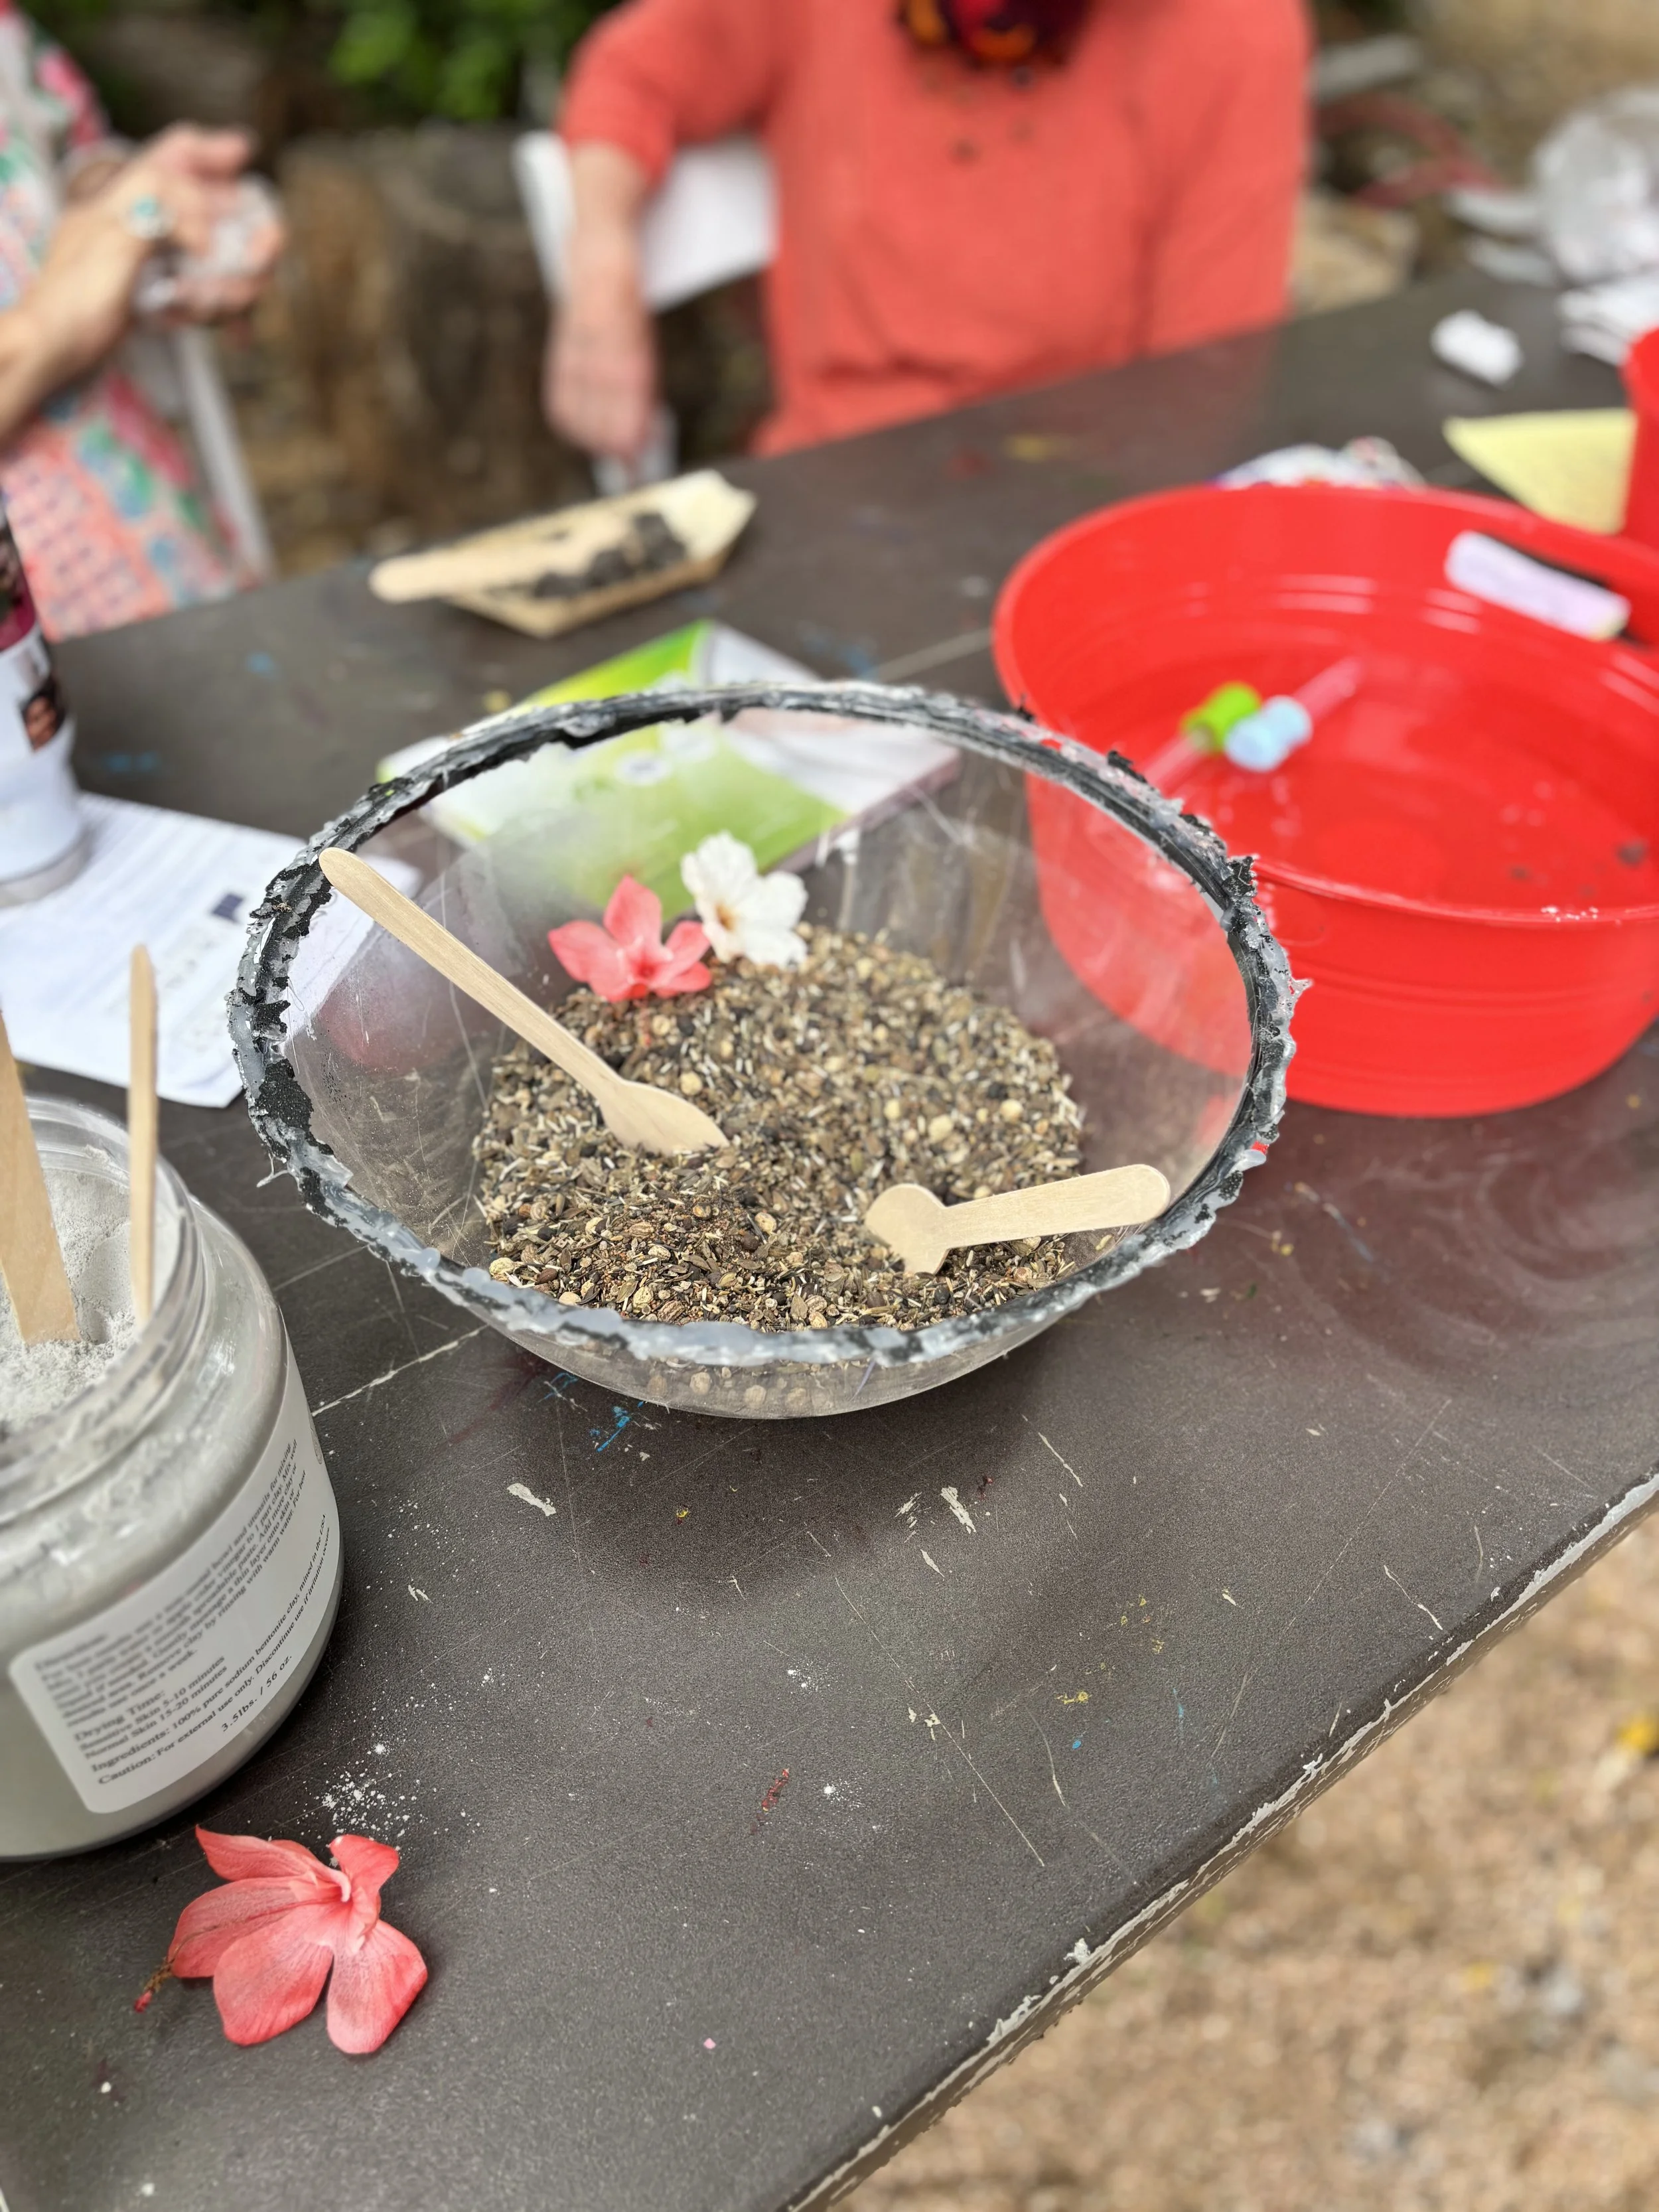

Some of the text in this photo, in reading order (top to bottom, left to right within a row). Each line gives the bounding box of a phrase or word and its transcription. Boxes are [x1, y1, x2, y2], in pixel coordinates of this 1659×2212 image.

[233, 1526, 248, 1547] and
[248, 1493, 271, 1528] utensils
[269, 1476, 279, 1491] for
[259, 1503, 271, 1526] part
[282, 1462, 291, 1482] Mix
[259, 1522, 272, 1543] Add
[271, 1496, 285, 1520] more
[284, 1475, 293, 1496] clay
[234, 1568, 250, 1586] thin
[250, 1544, 267, 1568] layer
[267, 1522, 280, 1543] onto
[279, 1502, 290, 1522] skin
[289, 1489, 294, 1501] or
[183, 1629, 203, 1648] clay
[204, 1616, 216, 1629] by
[218, 1585, 247, 1617] rinsing
[246, 1563, 263, 1585] with
[263, 1536, 280, 1562] warm
[91, 1728, 171, 1772] Ingredients:
[173, 1707, 202, 1729] 100%
[202, 1688, 224, 1709] pure
[225, 1656, 255, 1688] sodium
[255, 1614, 287, 1656] bentonite
[287, 1593, 300, 1613] clay,
[299, 1561, 313, 1592] mined
[312, 1552, 317, 1562] in
[98, 1753, 156, 1784] Caution:
[157, 1741, 176, 1755] For
[178, 1710, 216, 1743] external
[218, 1697, 234, 1712] use
[234, 1676, 255, 1696] only.
[255, 1622, 295, 1674] Discontinue
[295, 1605, 304, 1621] use
[303, 1593, 309, 1605] if
[308, 1556, 324, 1595] irritation
[135, 1706, 161, 1724] Skin
[163, 1687, 186, 1707] 5-10
[188, 1655, 226, 1690] minutes
[221, 1655, 292, 1732] 3.5lbs. / 56 oz.
[74, 1690, 166, 1741] Drying Time:
[131, 1720, 158, 1737] Skin
[160, 1697, 189, 1721] 15-20
[190, 1666, 228, 1699] minutes
